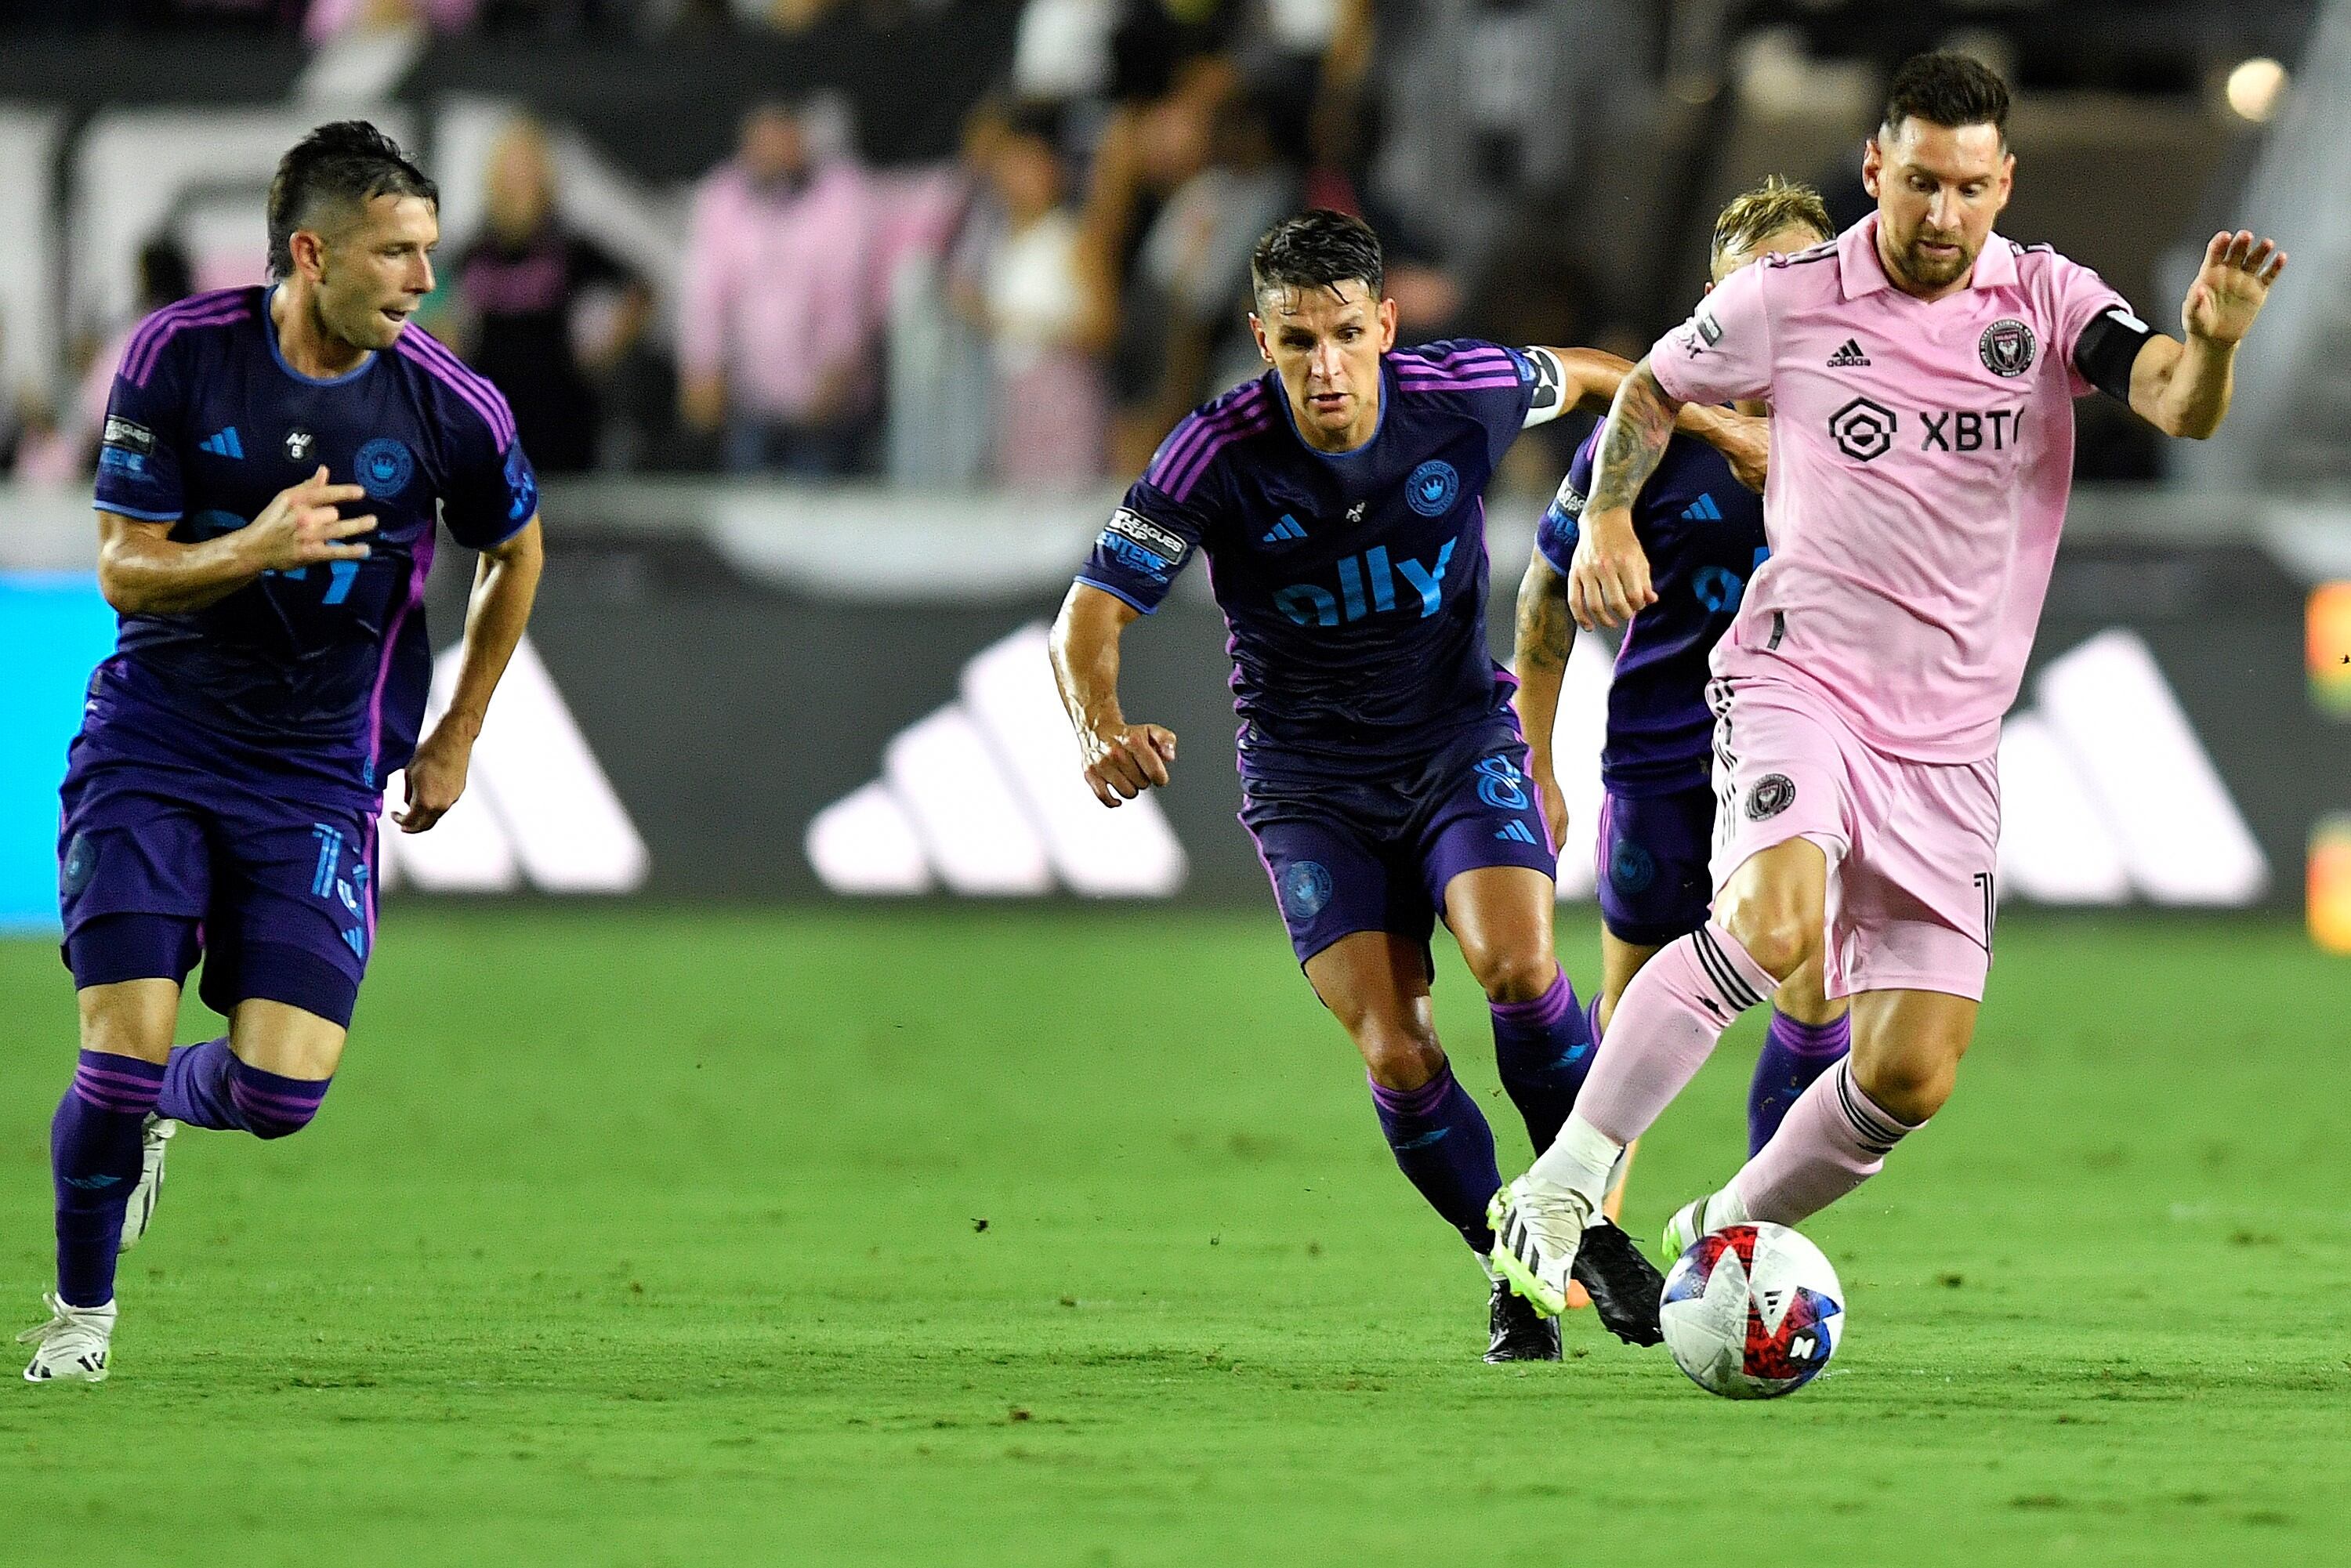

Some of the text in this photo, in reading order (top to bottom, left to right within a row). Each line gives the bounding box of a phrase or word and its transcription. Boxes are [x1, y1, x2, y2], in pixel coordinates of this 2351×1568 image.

[1826, 356, 1871, 368] adidas
[1120, 521, 1148, 541] CUP
[1124, 514, 1183, 552] LEAGUES
[1272, 536, 1458, 626] ally
[1473, 754, 1529, 810] 8
